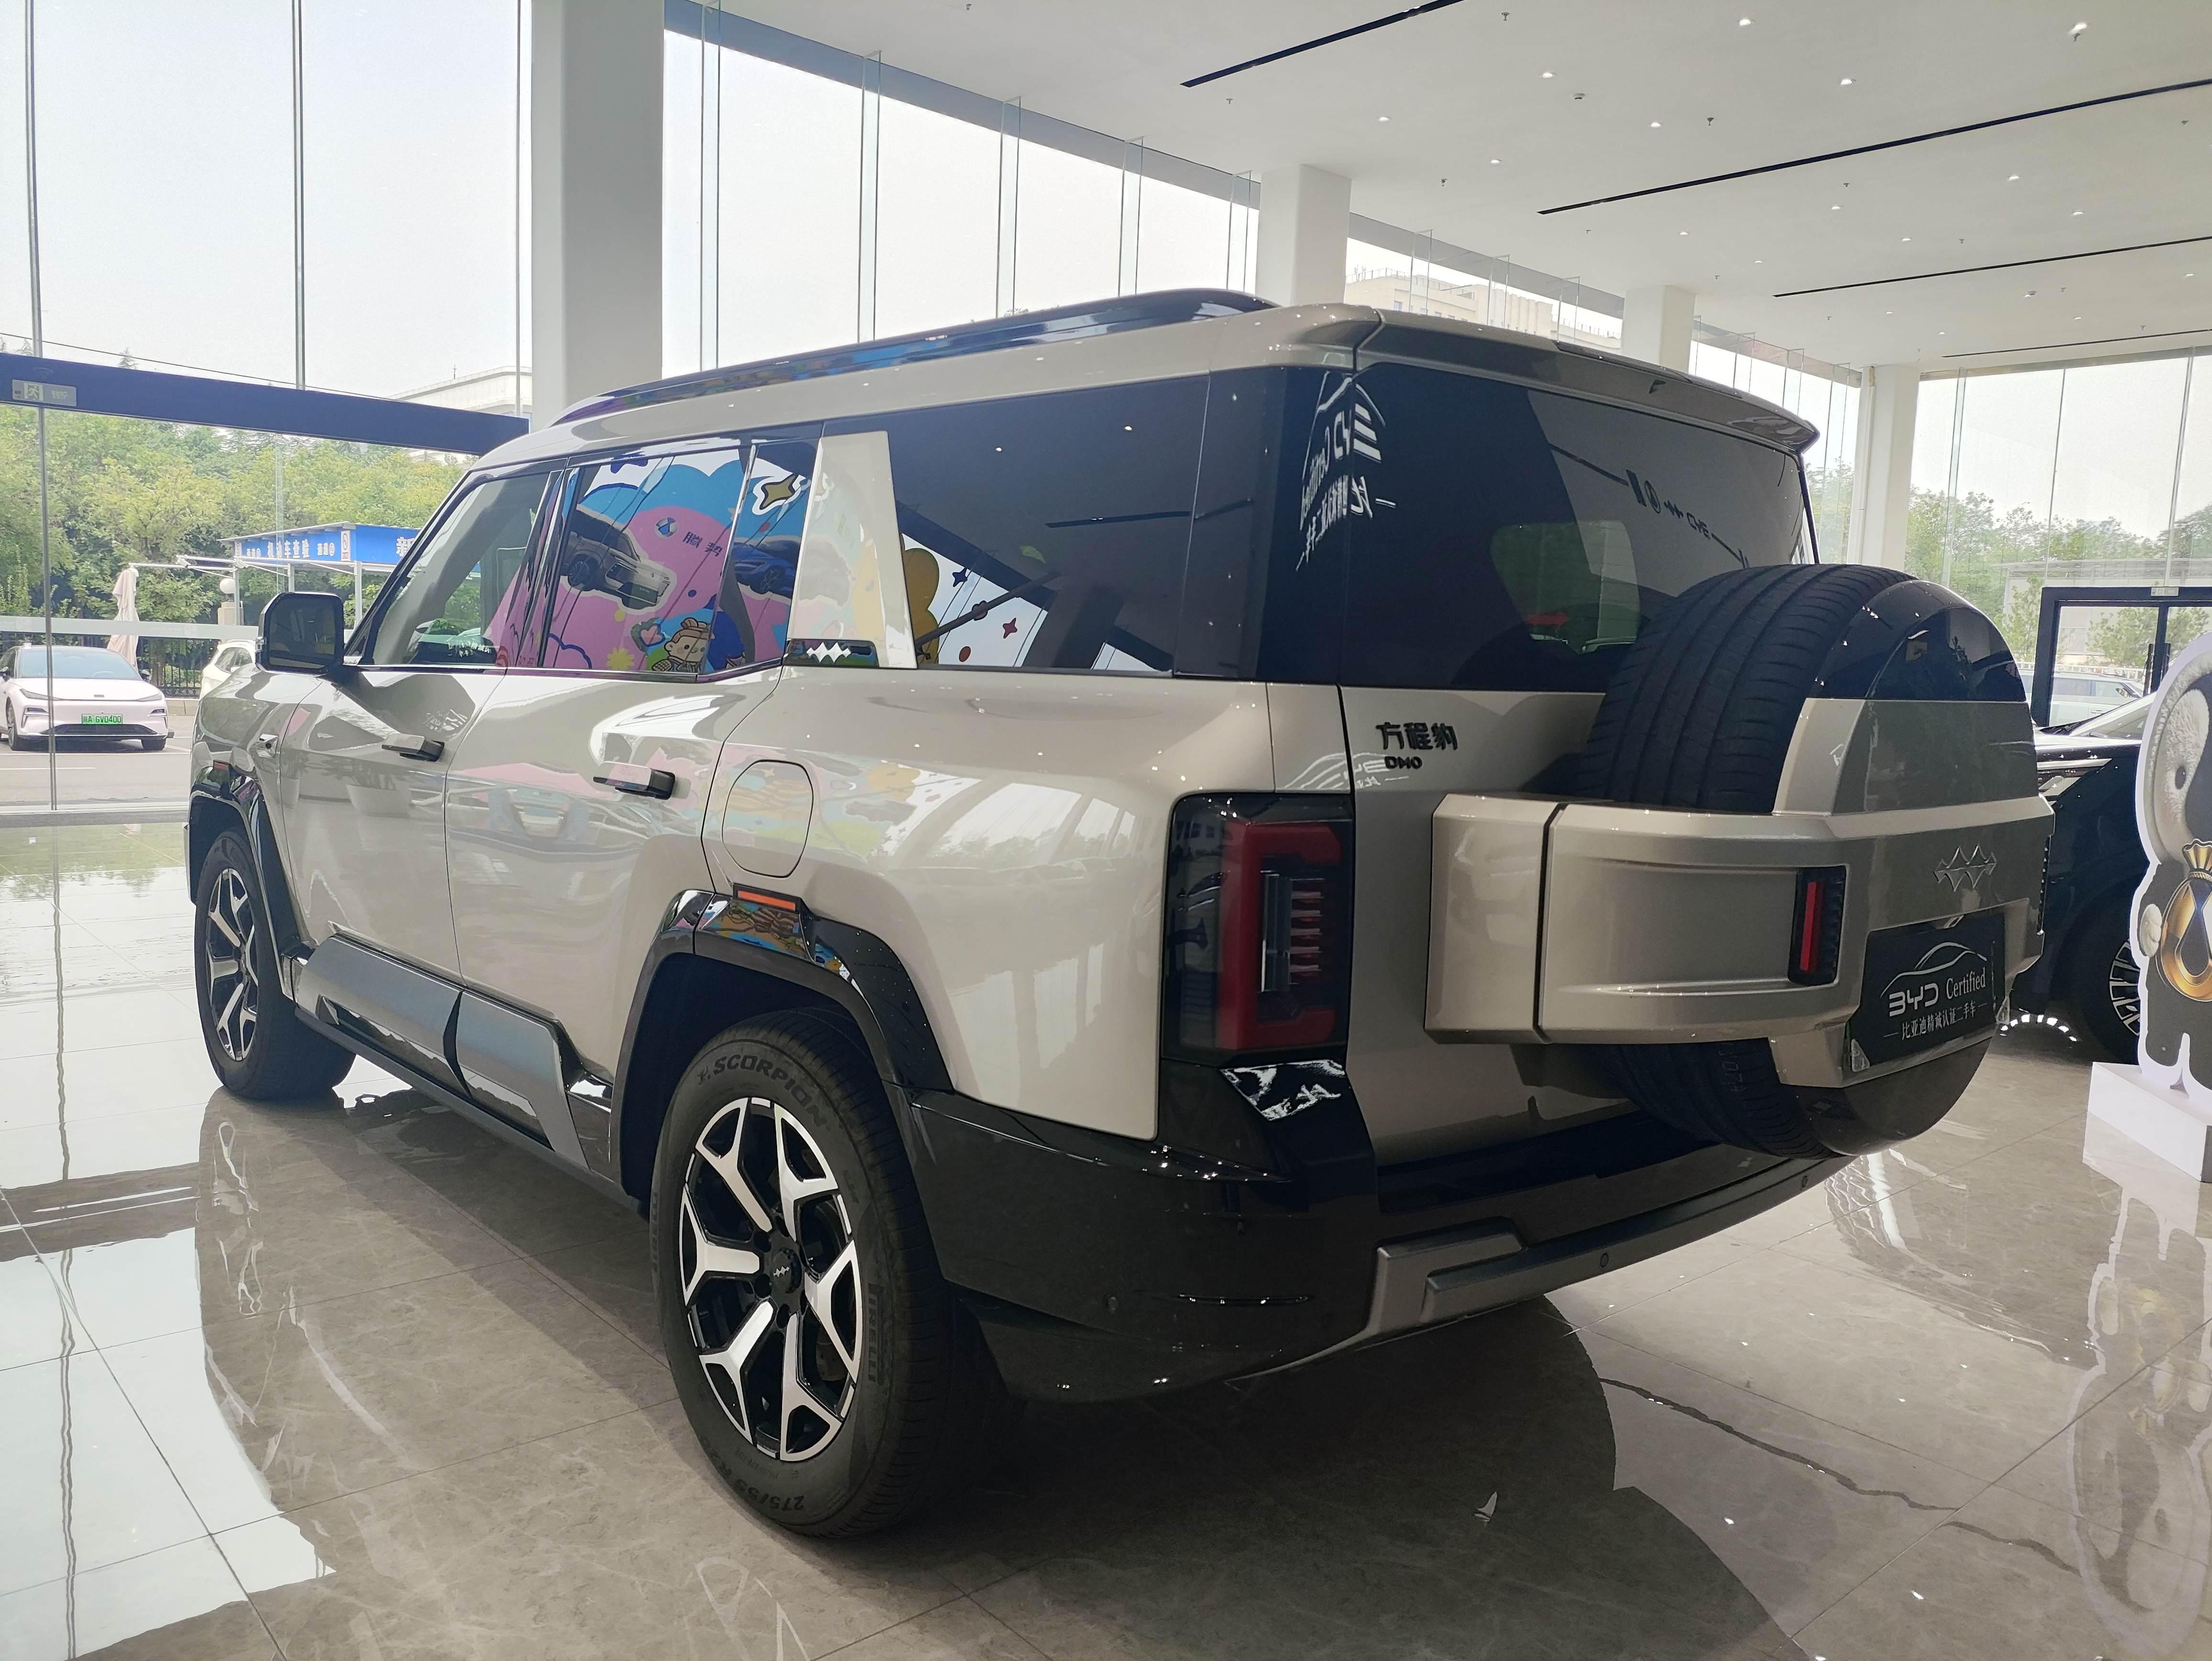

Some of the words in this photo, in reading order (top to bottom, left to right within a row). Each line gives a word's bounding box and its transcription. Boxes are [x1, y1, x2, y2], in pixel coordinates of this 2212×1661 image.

[1375, 721, 1458, 751] 方程豹
[1889, 983, 1939, 1017] BYD
[1946, 967, 1986, 1000] Certified
[1901, 1000, 1976, 1041] 比亚迪精诚认证二手车
[713, 1054, 827, 1127] SCORPION
